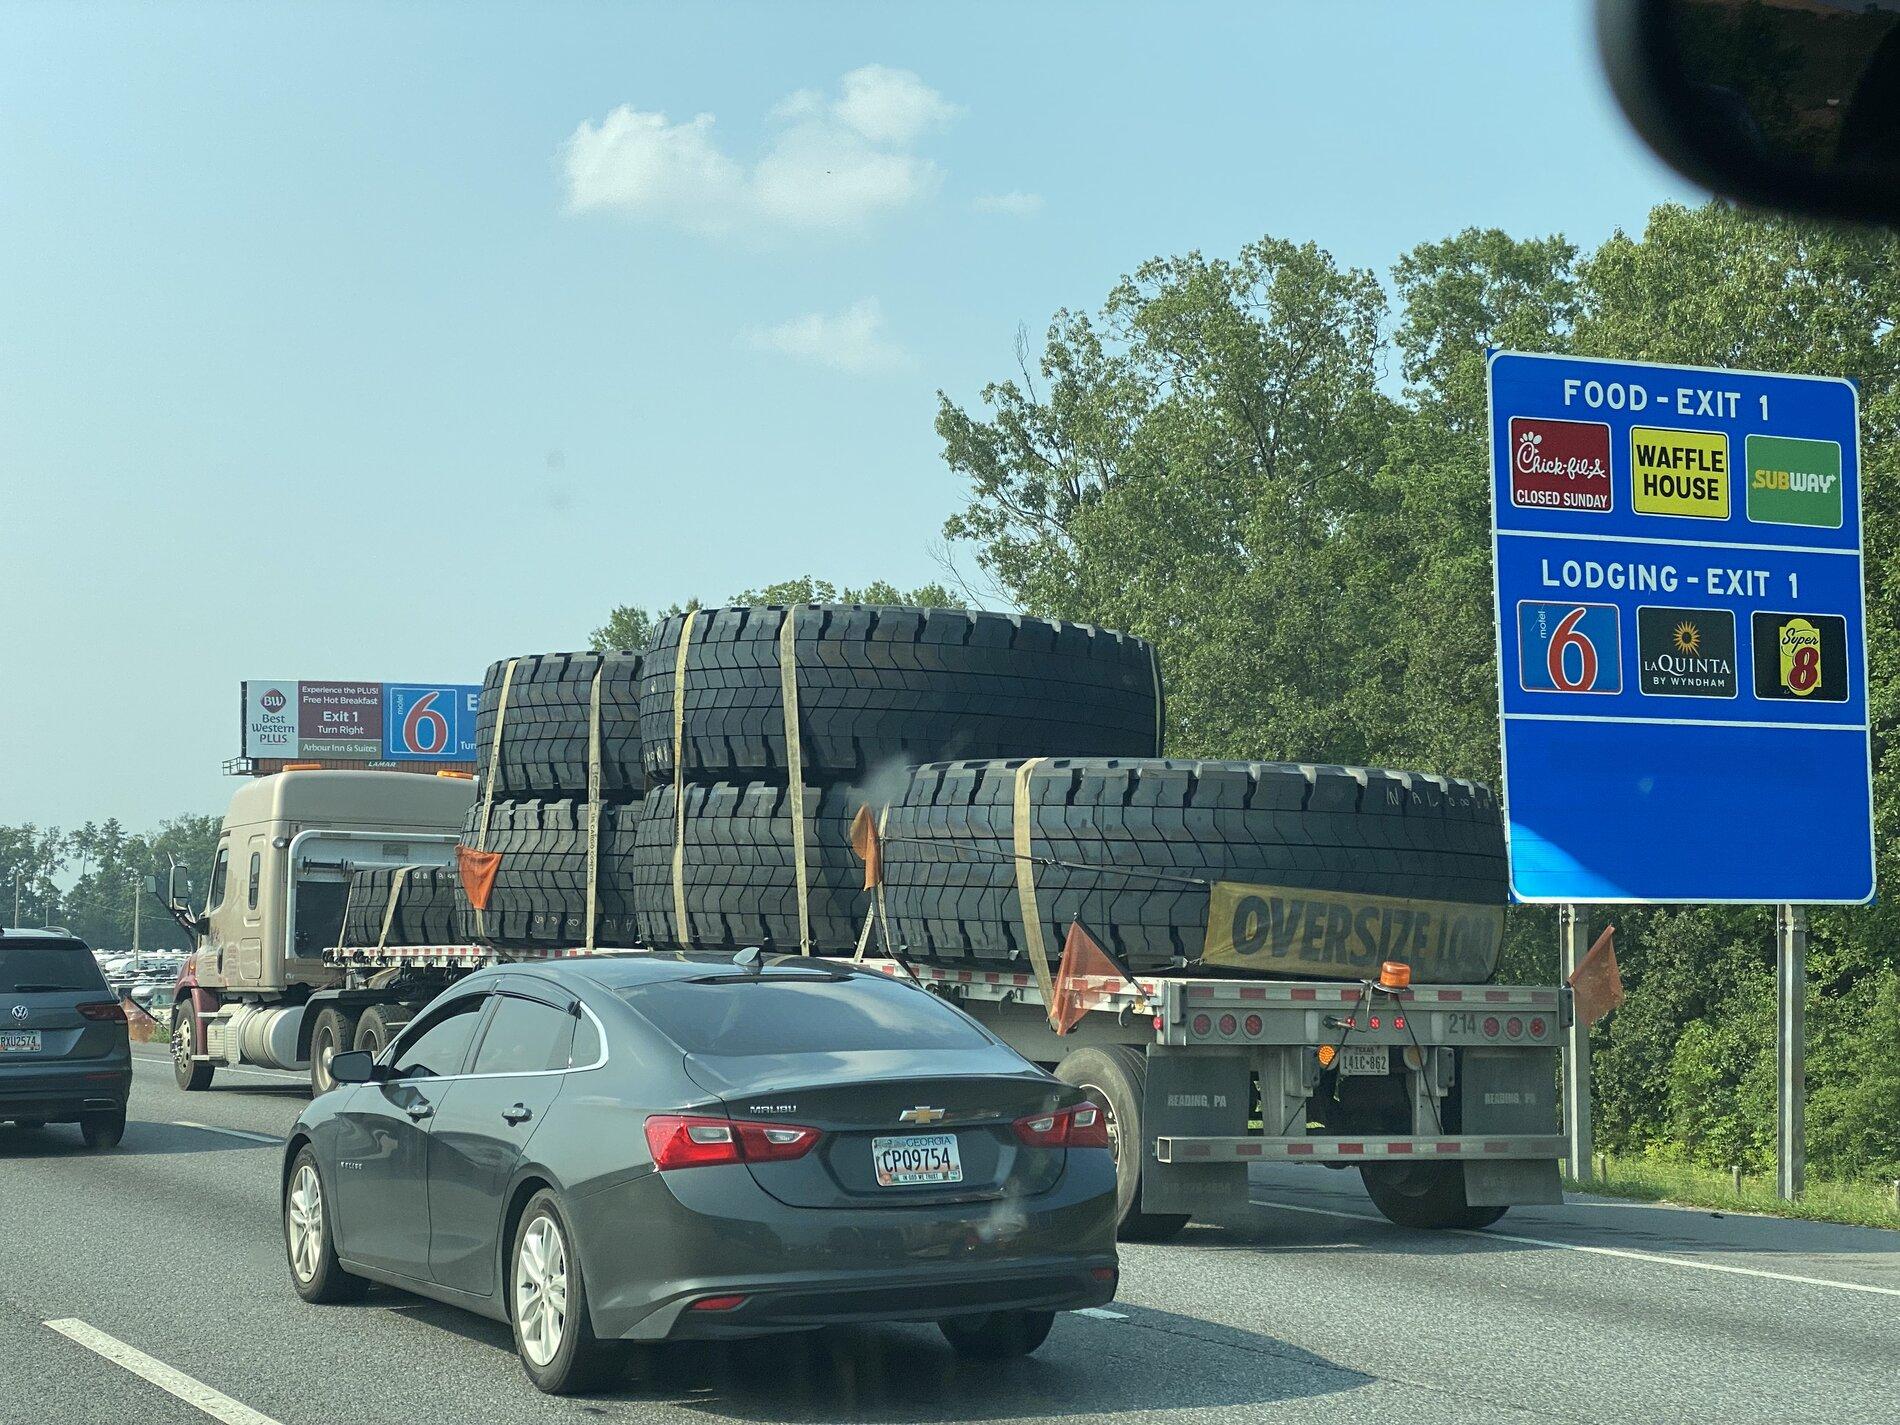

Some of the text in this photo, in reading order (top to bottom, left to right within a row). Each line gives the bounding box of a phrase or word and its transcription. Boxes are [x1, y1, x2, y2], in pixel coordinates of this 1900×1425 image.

[1563, 379, 1648, 411] FOOD
[1677, 388, 1741, 418] EXIT
[1759, 395, 1768, 421] 1
[1517, 440, 1606, 480] Chick-fil-A
[1636, 444, 1725, 473] WAFFLE
[1643, 473, 1720, 501] HOUSE
[1752, 469, 1837, 493] SUBWAY
[1516, 489, 1608, 508] CLOSED SUNDAY
[1541, 559, 1678, 592] LODGING
[1707, 568, 1770, 597] EXIT
[1788, 572, 1798, 599] 1
[1538, 610, 1547, 639] motel
[1546, 607, 1598, 691] 6
[1781, 627, 1819, 653] Super
[1788, 646, 1820, 691] 8
[302, 685, 342, 695] Experience
[344, 686, 355, 694] the
[1653, 676, 1725, 688] BY WYNDHAM
[263, 696, 283, 707] BW
[303, 695, 378, 705] Free Hot Breakfast
[262, 714, 285, 724] Best
[323, 710, 358, 722] Exit 1
[403, 691, 449, 754] 6
[252, 723, 295, 733] Western
[317, 725, 364, 735] Turn Right
[260, 734, 287, 744] PLUS
[303, 743, 377, 753] Arbour Inn & Suites
[368, 760, 396, 768] LAMAR
[1232, 894, 1431, 976] OVERSIZE
[1449, 1013, 1475, 1034] 214
[750, 1104, 797, 1114] MALIBU
[1214, 1095, 1227, 1108] PA
[906, 1136, 952, 1147] GEORGIA
[882, 1147, 951, 1173] CPQ9754
